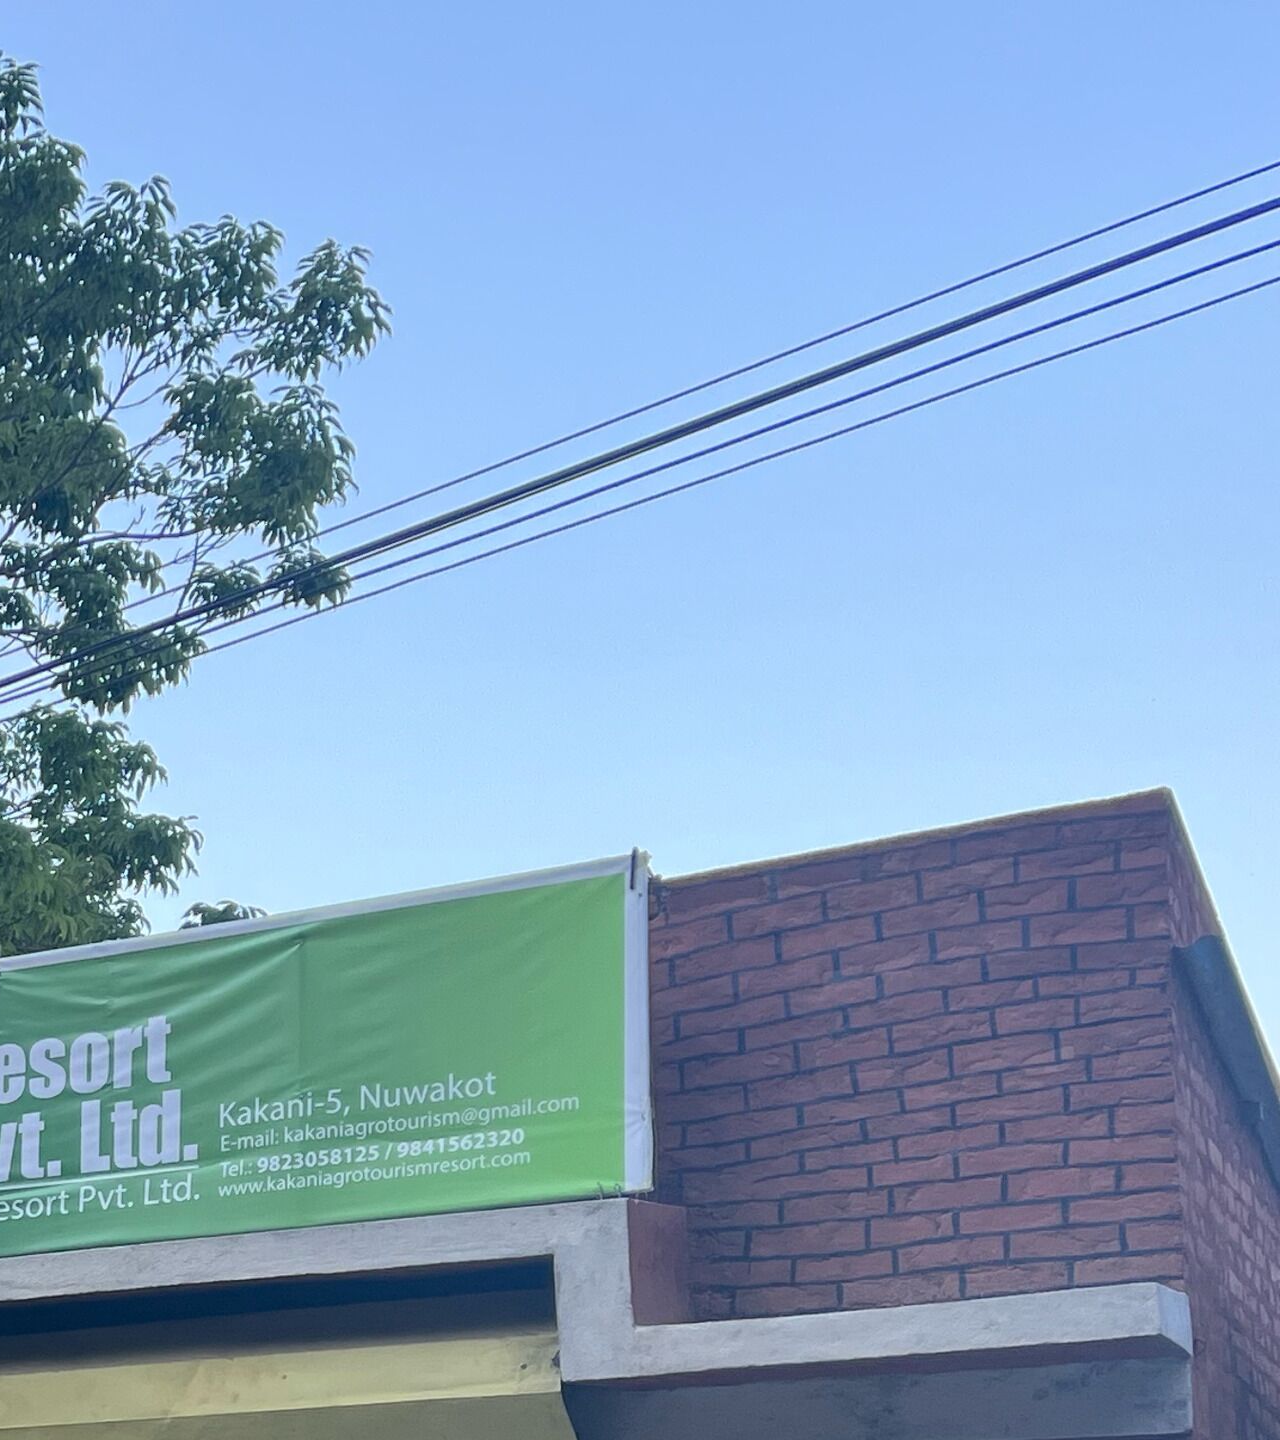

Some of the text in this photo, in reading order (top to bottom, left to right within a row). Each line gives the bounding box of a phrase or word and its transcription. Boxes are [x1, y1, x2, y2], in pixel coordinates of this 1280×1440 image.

[219, 1072, 497, 1128] Kakani-5, Nuwakot
[220, 1096, 580, 1152] E-mail: kakaniagrotourism@gmail.com
[80, 1089, 199, 1174] Ltd.
[257, 1145, 380, 1174] 9823058125
[384, 1142, 393, 1160] /
[397, 1128, 526, 1158] 9841562320
[79, 1184, 134, 1213] Pvt.
[144, 1173, 200, 1205] Ltd.
[218, 1151, 531, 1197] www.kakaniagrotourismresort.com
